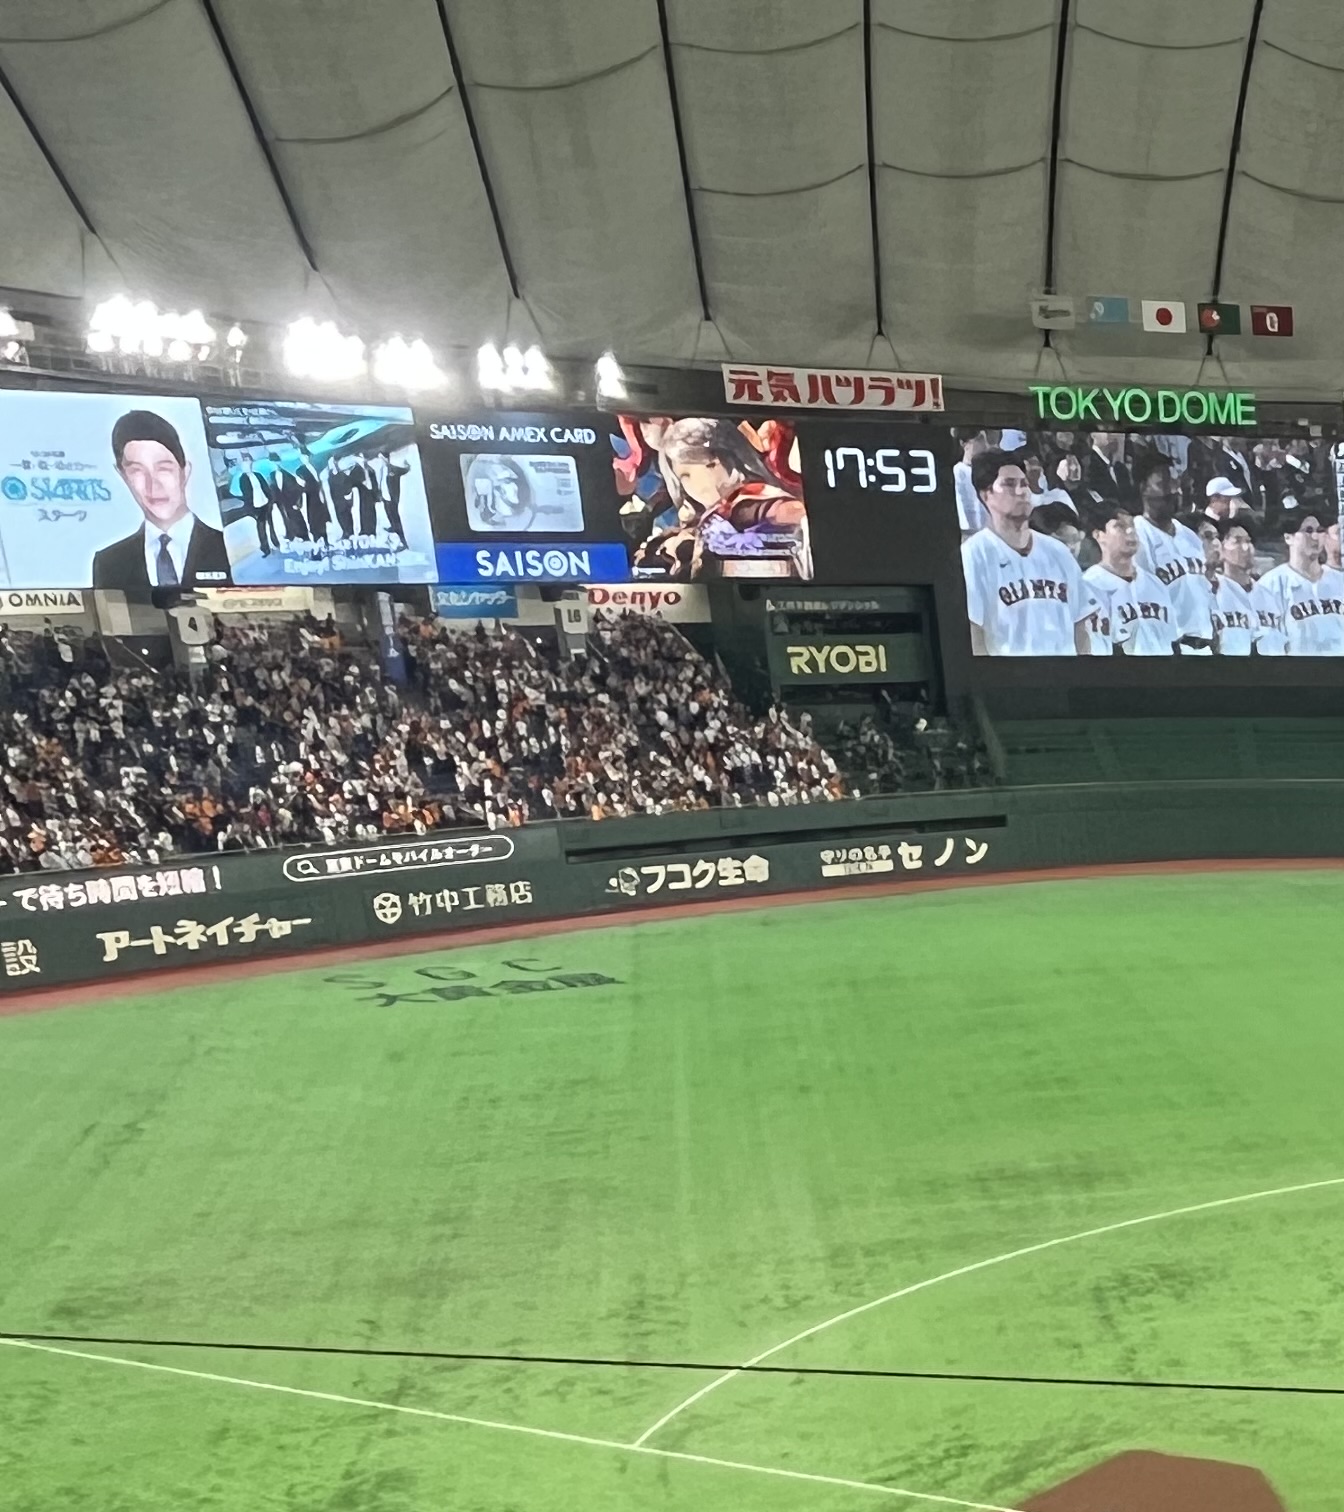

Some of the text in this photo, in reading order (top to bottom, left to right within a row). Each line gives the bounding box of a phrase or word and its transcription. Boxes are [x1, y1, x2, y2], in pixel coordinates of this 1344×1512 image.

[1028, 386, 1256, 426] TOKYO DOME
[430, 424, 596, 445] SAISON AMEX CARD
[825, 447, 937, 493] 17:53
[476, 550, 590, 577] SAISON
[589, 588, 681, 608] Denyo
[787, 644, 887, 675] RYOBI
[898, 836, 989, 870] セノン
[641, 854, 769, 894] フコク生命
[408, 880, 533, 917] 竹中工務店
[96, 913, 312, 962] アートネイチャー
